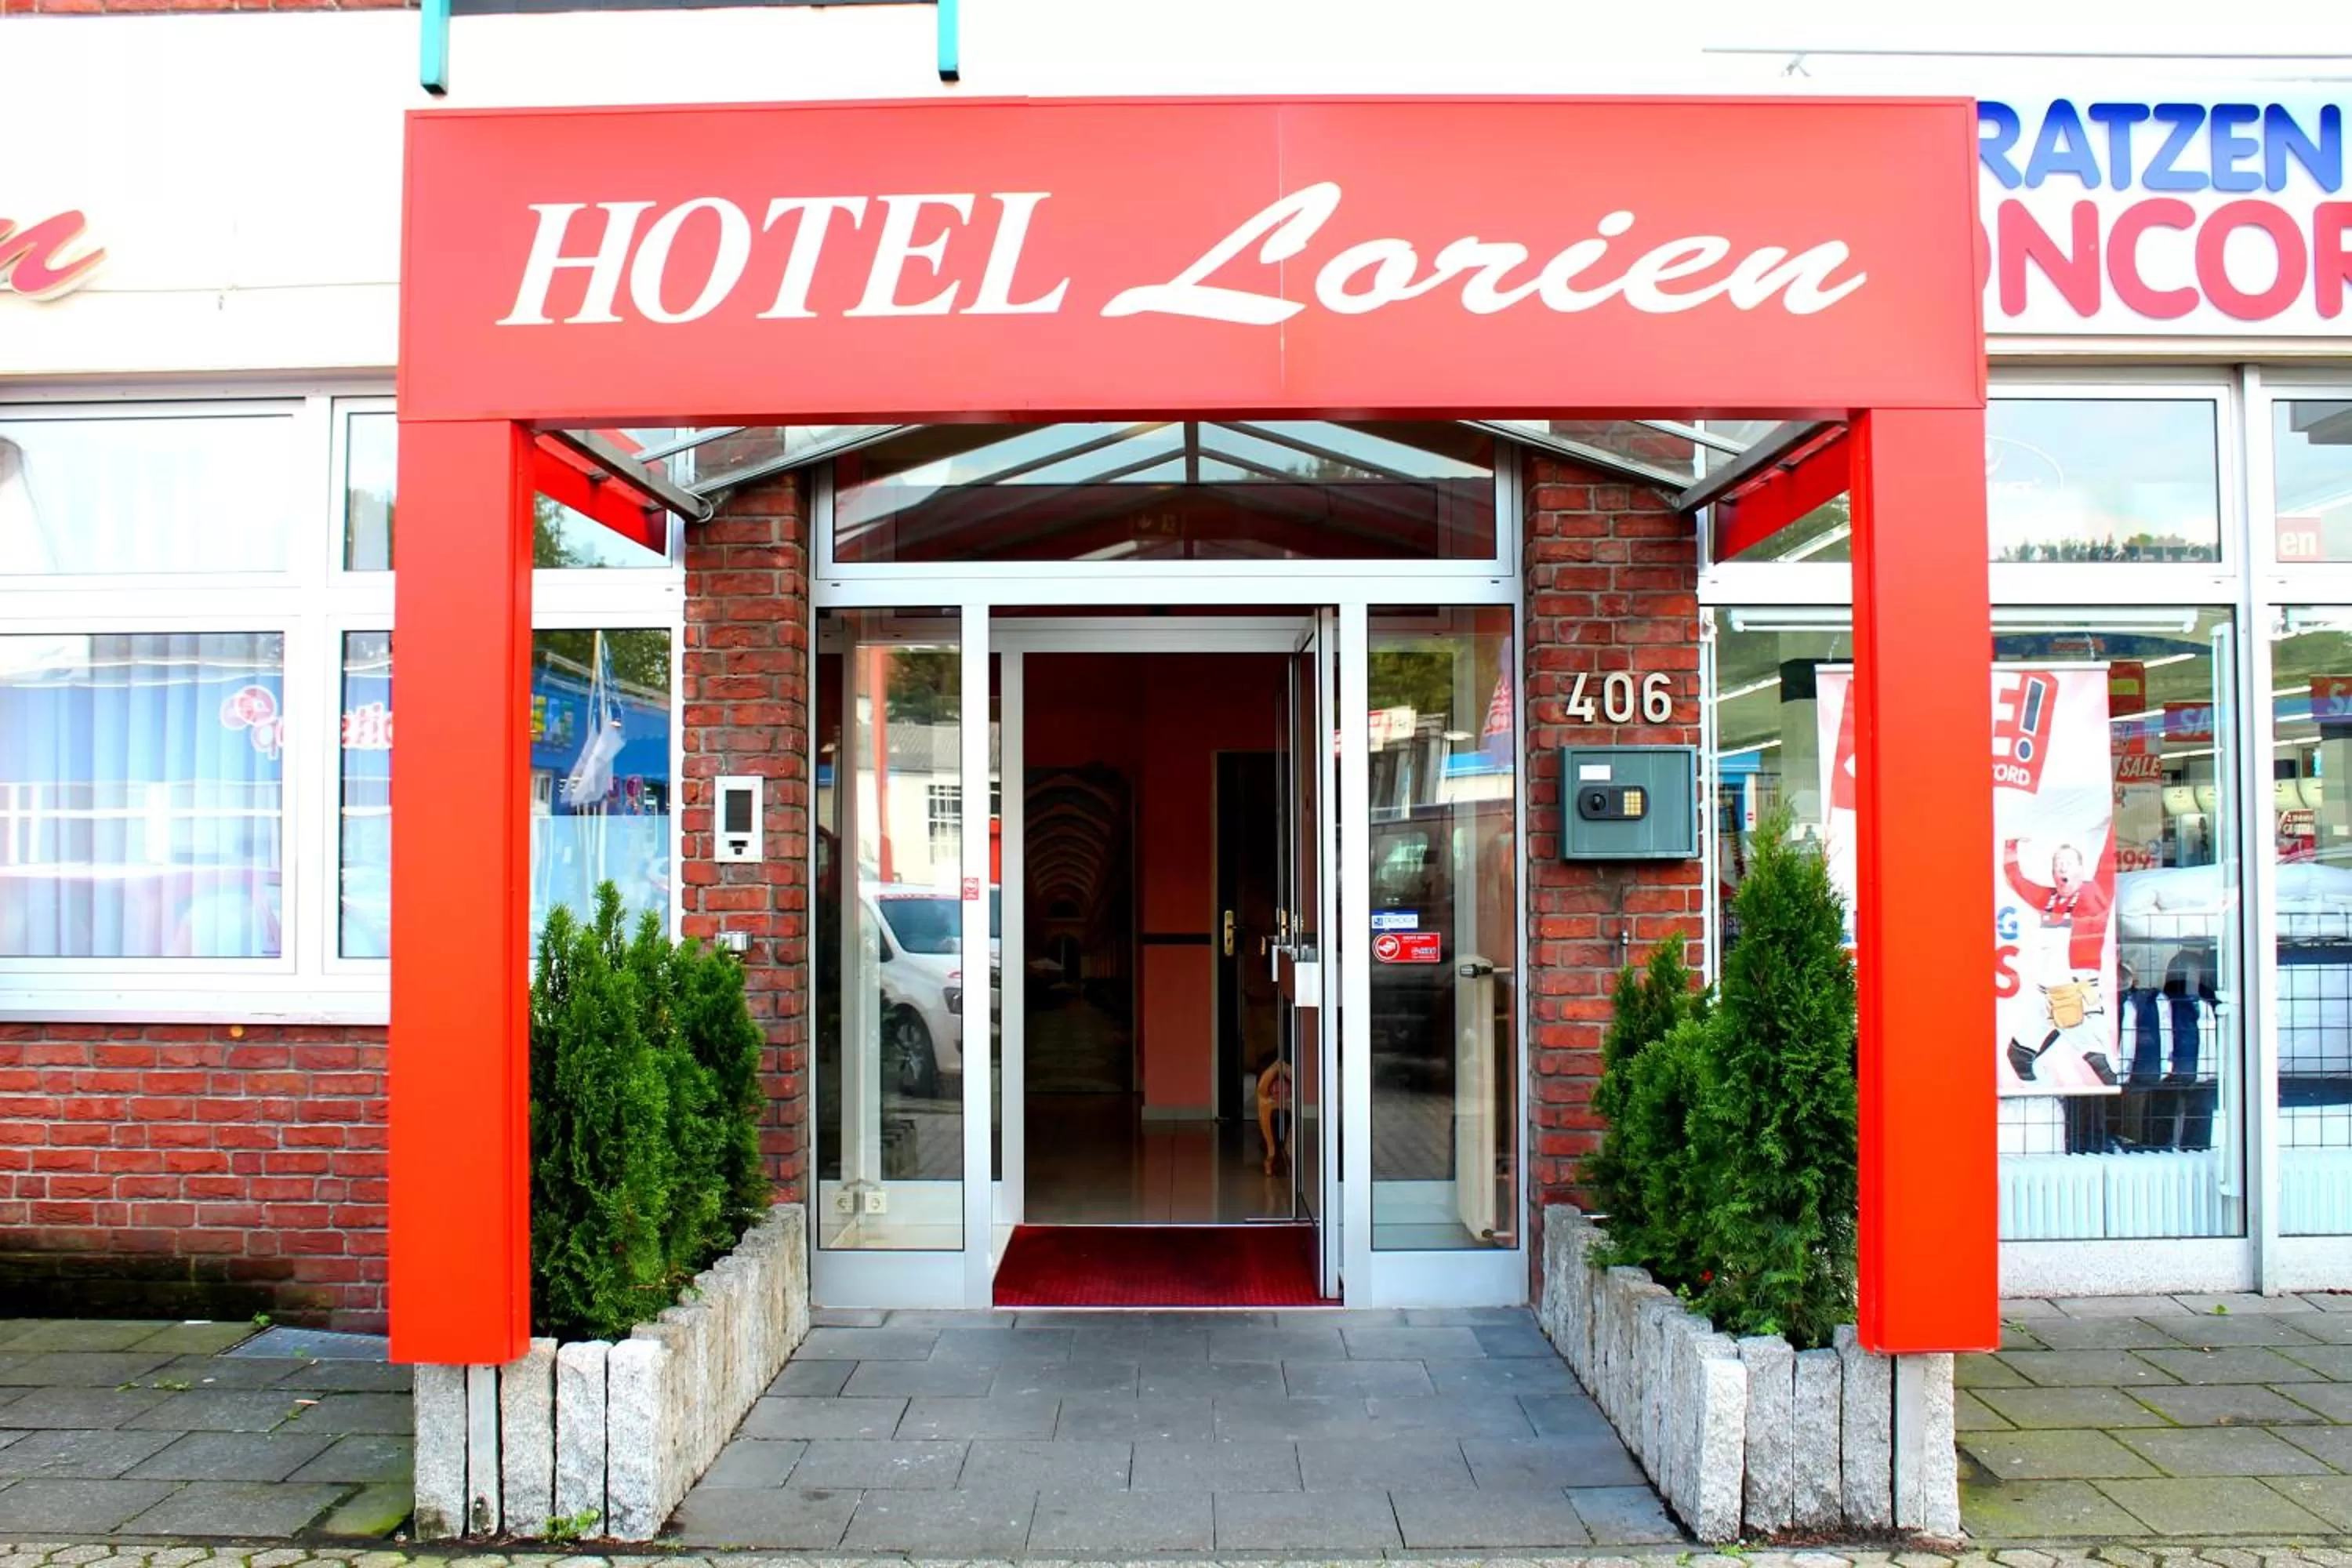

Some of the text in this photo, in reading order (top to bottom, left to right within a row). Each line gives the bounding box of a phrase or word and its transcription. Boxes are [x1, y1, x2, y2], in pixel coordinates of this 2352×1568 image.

[1977, 98, 2343, 193] RATZEN
[496, 181, 1866, 325] HOTEL Lorien
[1979, 198, 2352, 321] NCOR
[1566, 672, 1672, 723] 406
[1992, 763, 2031, 786] ORD
[2119, 756, 2161, 778] SALE
